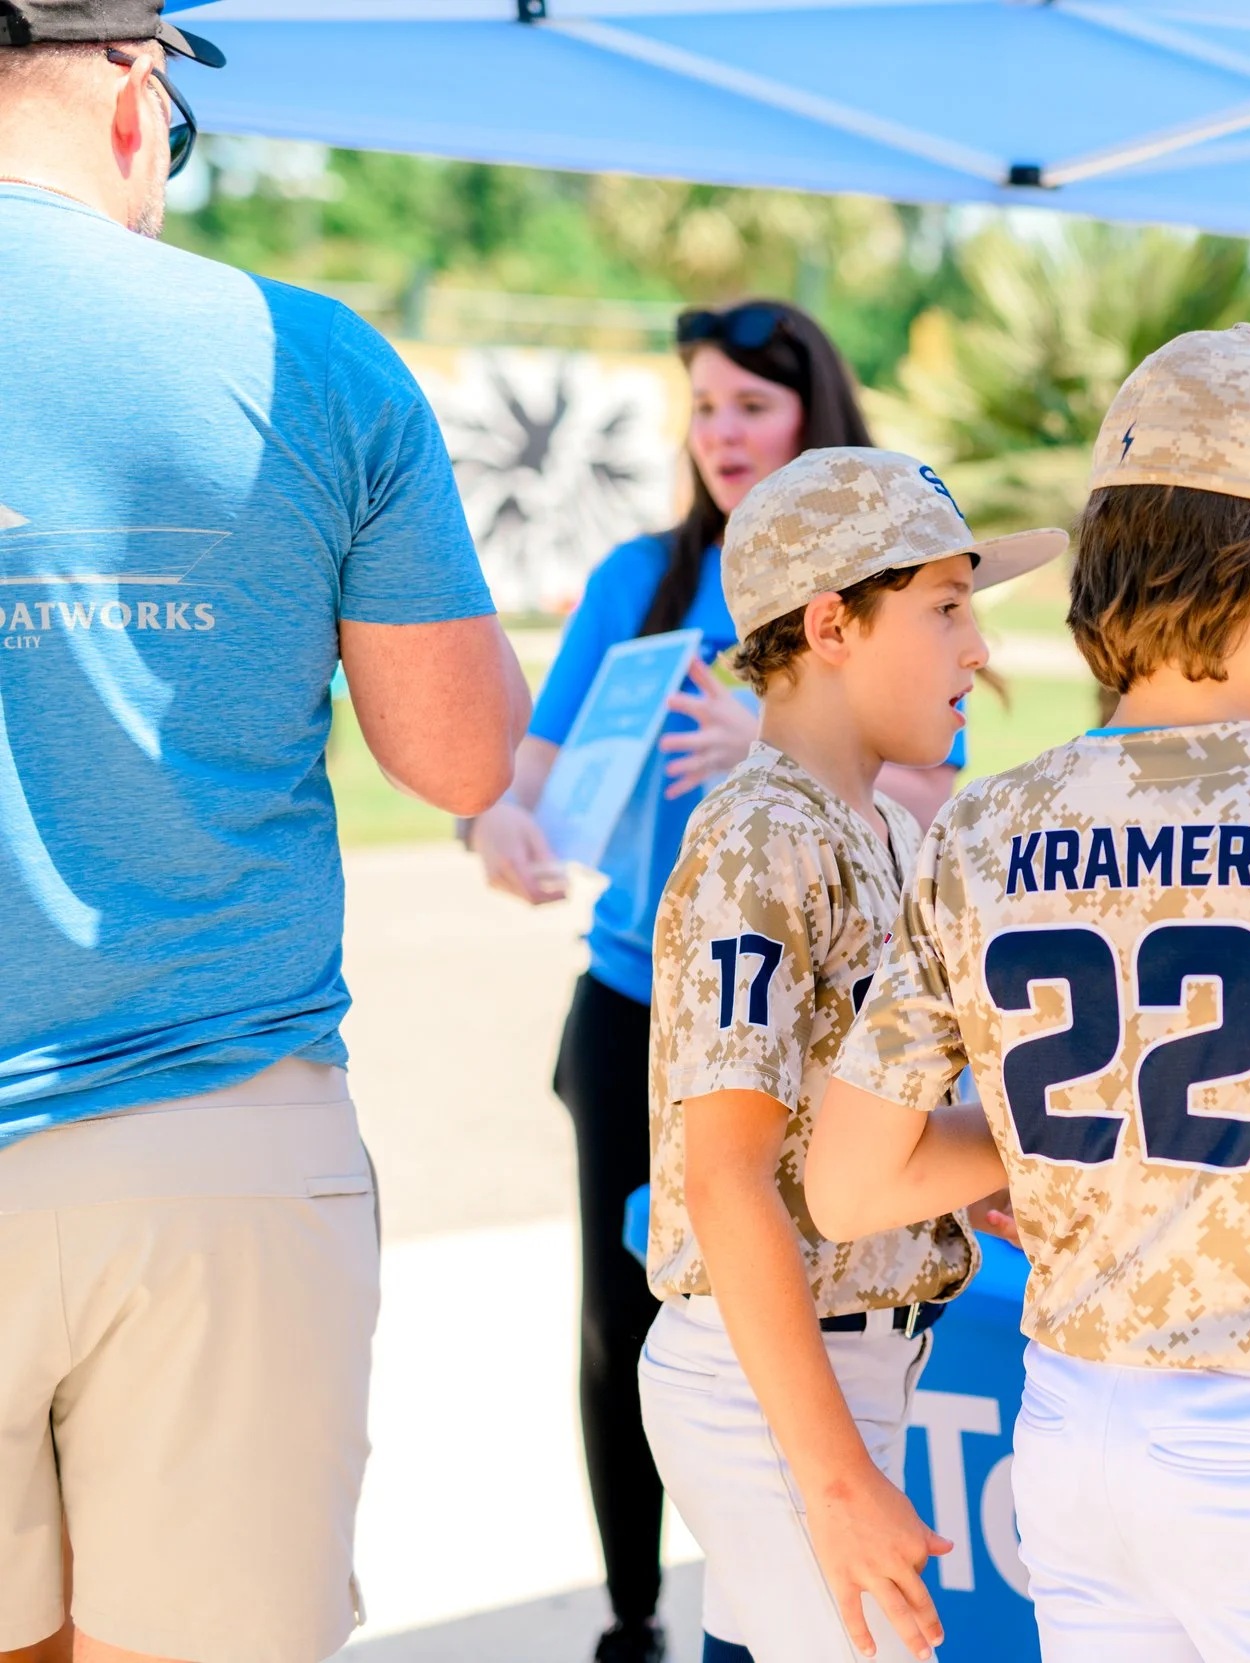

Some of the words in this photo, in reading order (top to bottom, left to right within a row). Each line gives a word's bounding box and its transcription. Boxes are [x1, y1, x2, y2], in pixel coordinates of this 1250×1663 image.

[0, 601, 216, 631] ATWORKS
[3, 635, 42, 650] CITY
[710, 931, 785, 1031] 17
